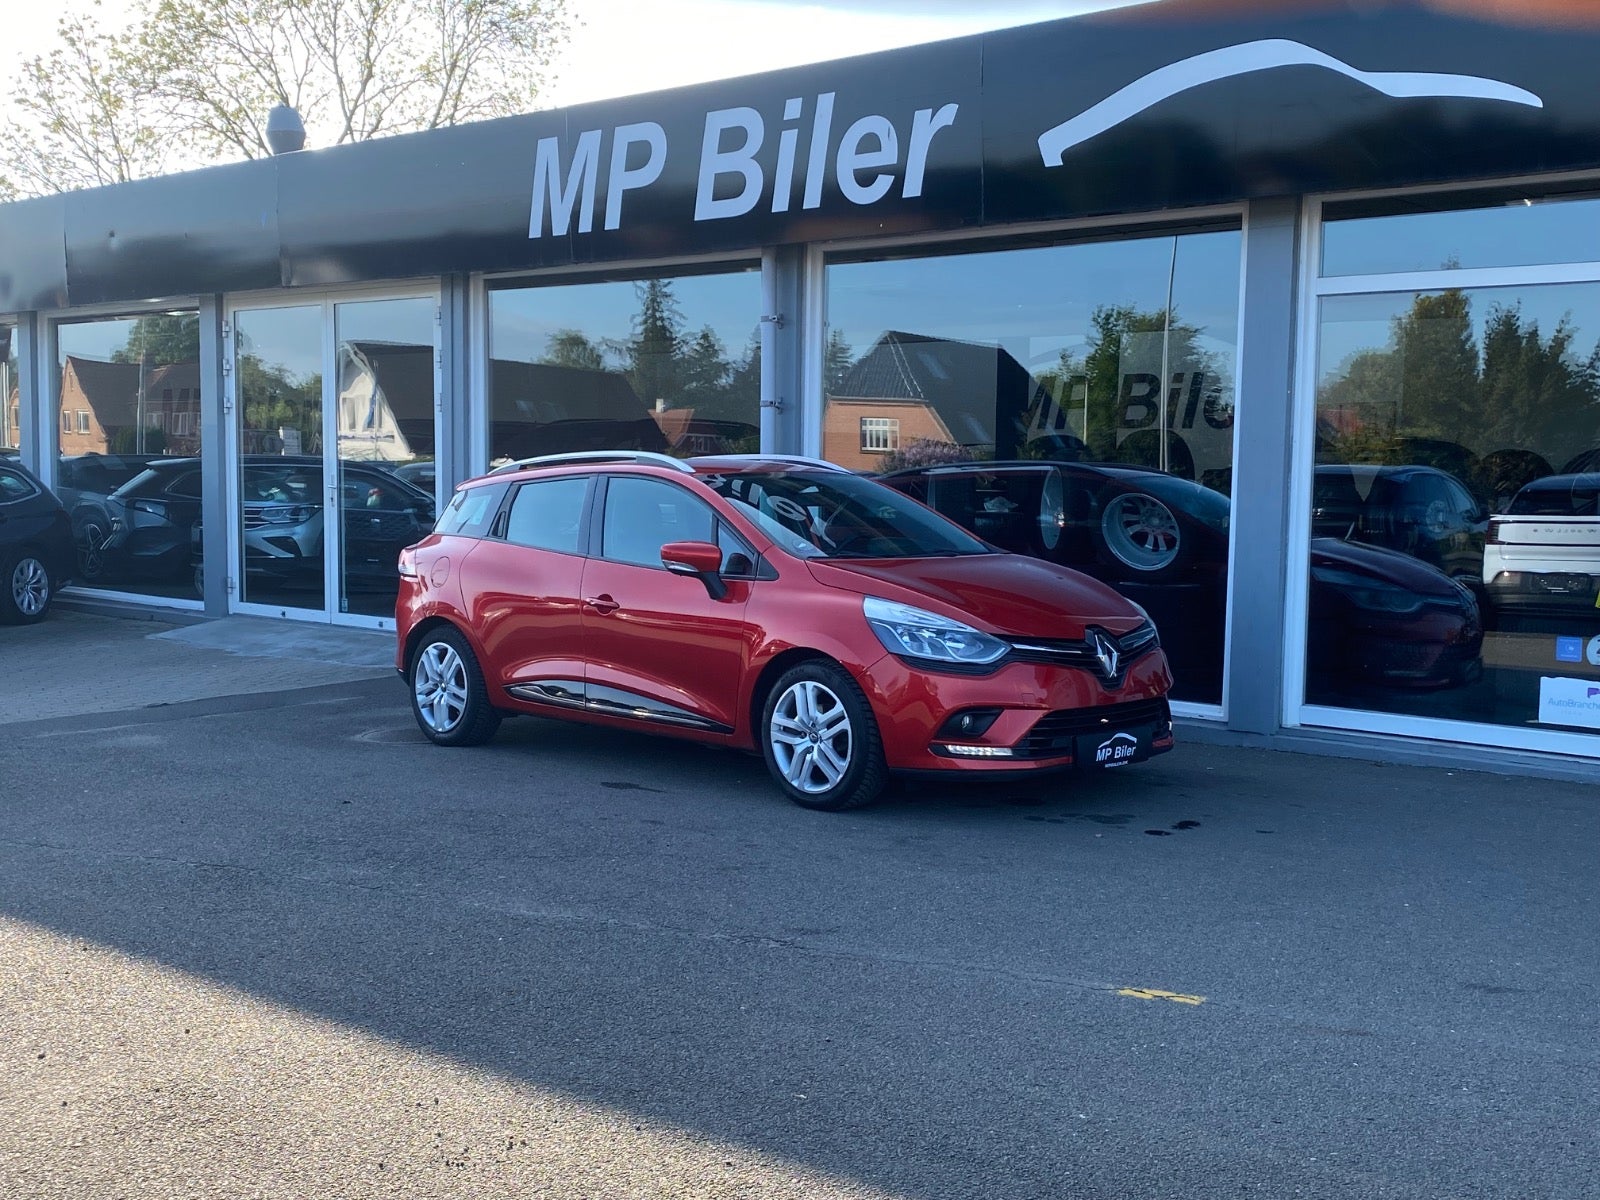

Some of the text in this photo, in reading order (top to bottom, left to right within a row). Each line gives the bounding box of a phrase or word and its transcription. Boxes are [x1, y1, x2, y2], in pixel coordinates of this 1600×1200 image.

[528, 91, 959, 239] MP Biler
[1096, 745, 1136, 761] MP Biler
